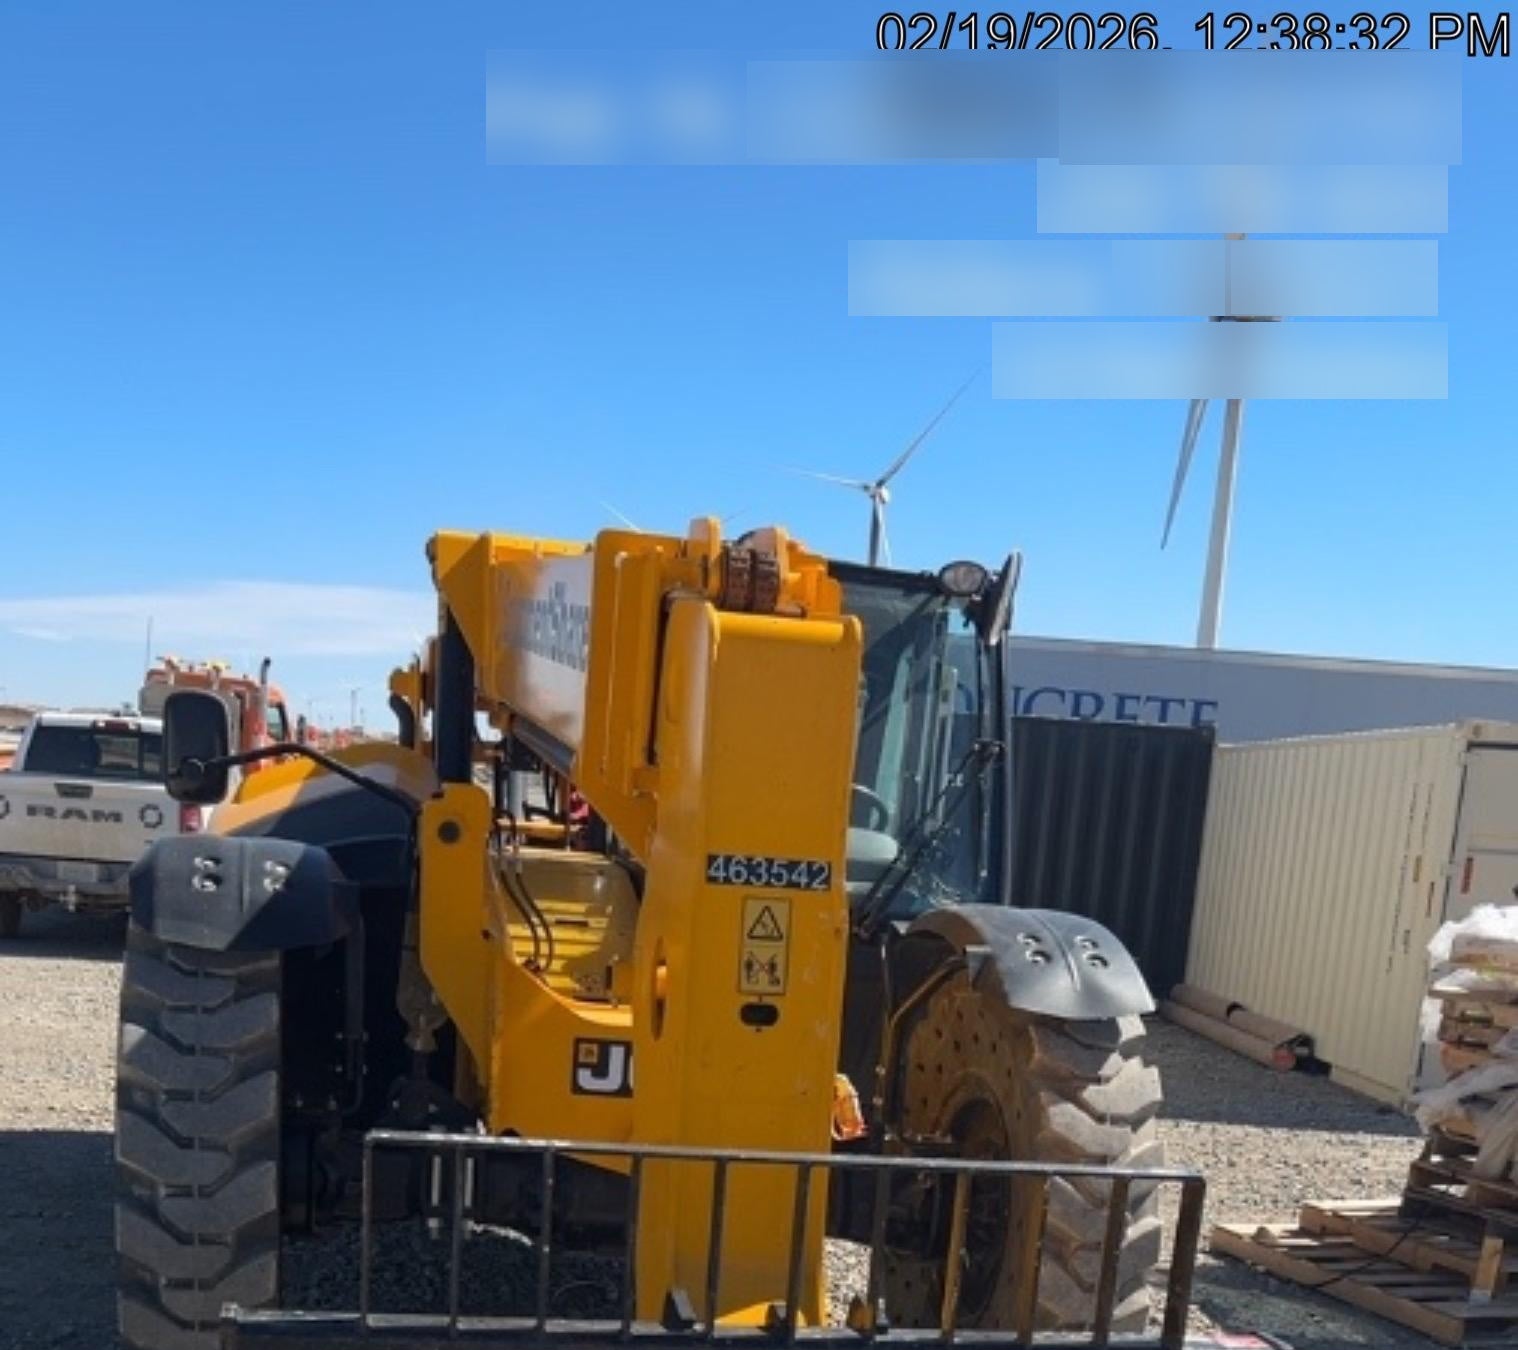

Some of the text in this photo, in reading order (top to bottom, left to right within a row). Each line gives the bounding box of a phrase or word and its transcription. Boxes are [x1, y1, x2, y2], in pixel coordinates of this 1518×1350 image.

[26, 804, 122, 823] RAM
[707, 855, 830, 889] 463542
[577, 1043, 634, 1093] J
